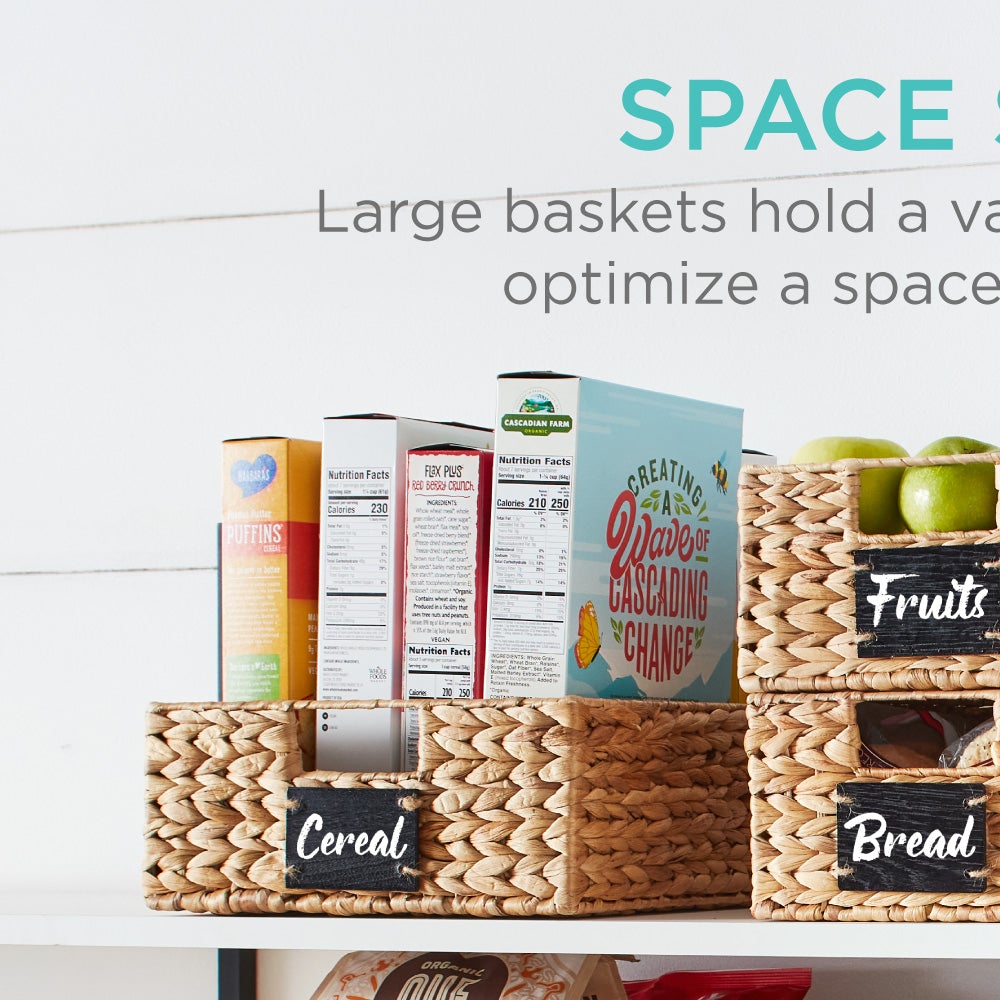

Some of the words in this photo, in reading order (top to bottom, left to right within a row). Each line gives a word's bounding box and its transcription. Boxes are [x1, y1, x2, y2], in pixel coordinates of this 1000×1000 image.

[504, 419, 548, 428] CASCADIAN
[549, 420, 570, 428] FARM
[499, 456, 541, 465] Nutrition
[545, 457, 571, 466] Facts
[328, 469, 365, 480] Nutrition
[366, 470, 390, 480] Facts
[627, 457, 703, 507] CREATING
[327, 505, 356, 514] Calories
[371, 503, 388, 514] 230
[497, 498, 525, 507] Calories
[529, 497, 547, 508] 210
[551, 498, 569, 509] 250
[661, 490, 672, 516] A
[226, 523, 283, 545] PUFFINS
[606, 489, 695, 580] Wave
[695, 528, 710, 552] OF
[608, 562, 709, 622] CASCADING
[866, 573, 989, 628] Fruits
[408, 646, 447, 656] Nutrition
[450, 647, 471, 656] Facts
[623, 620, 695, 683] CHANGE
[408, 688, 427, 696] Calories
[459, 688, 471, 698] 250
[296, 812, 408, 860] Cereal
[843, 811, 977, 863] Bread
